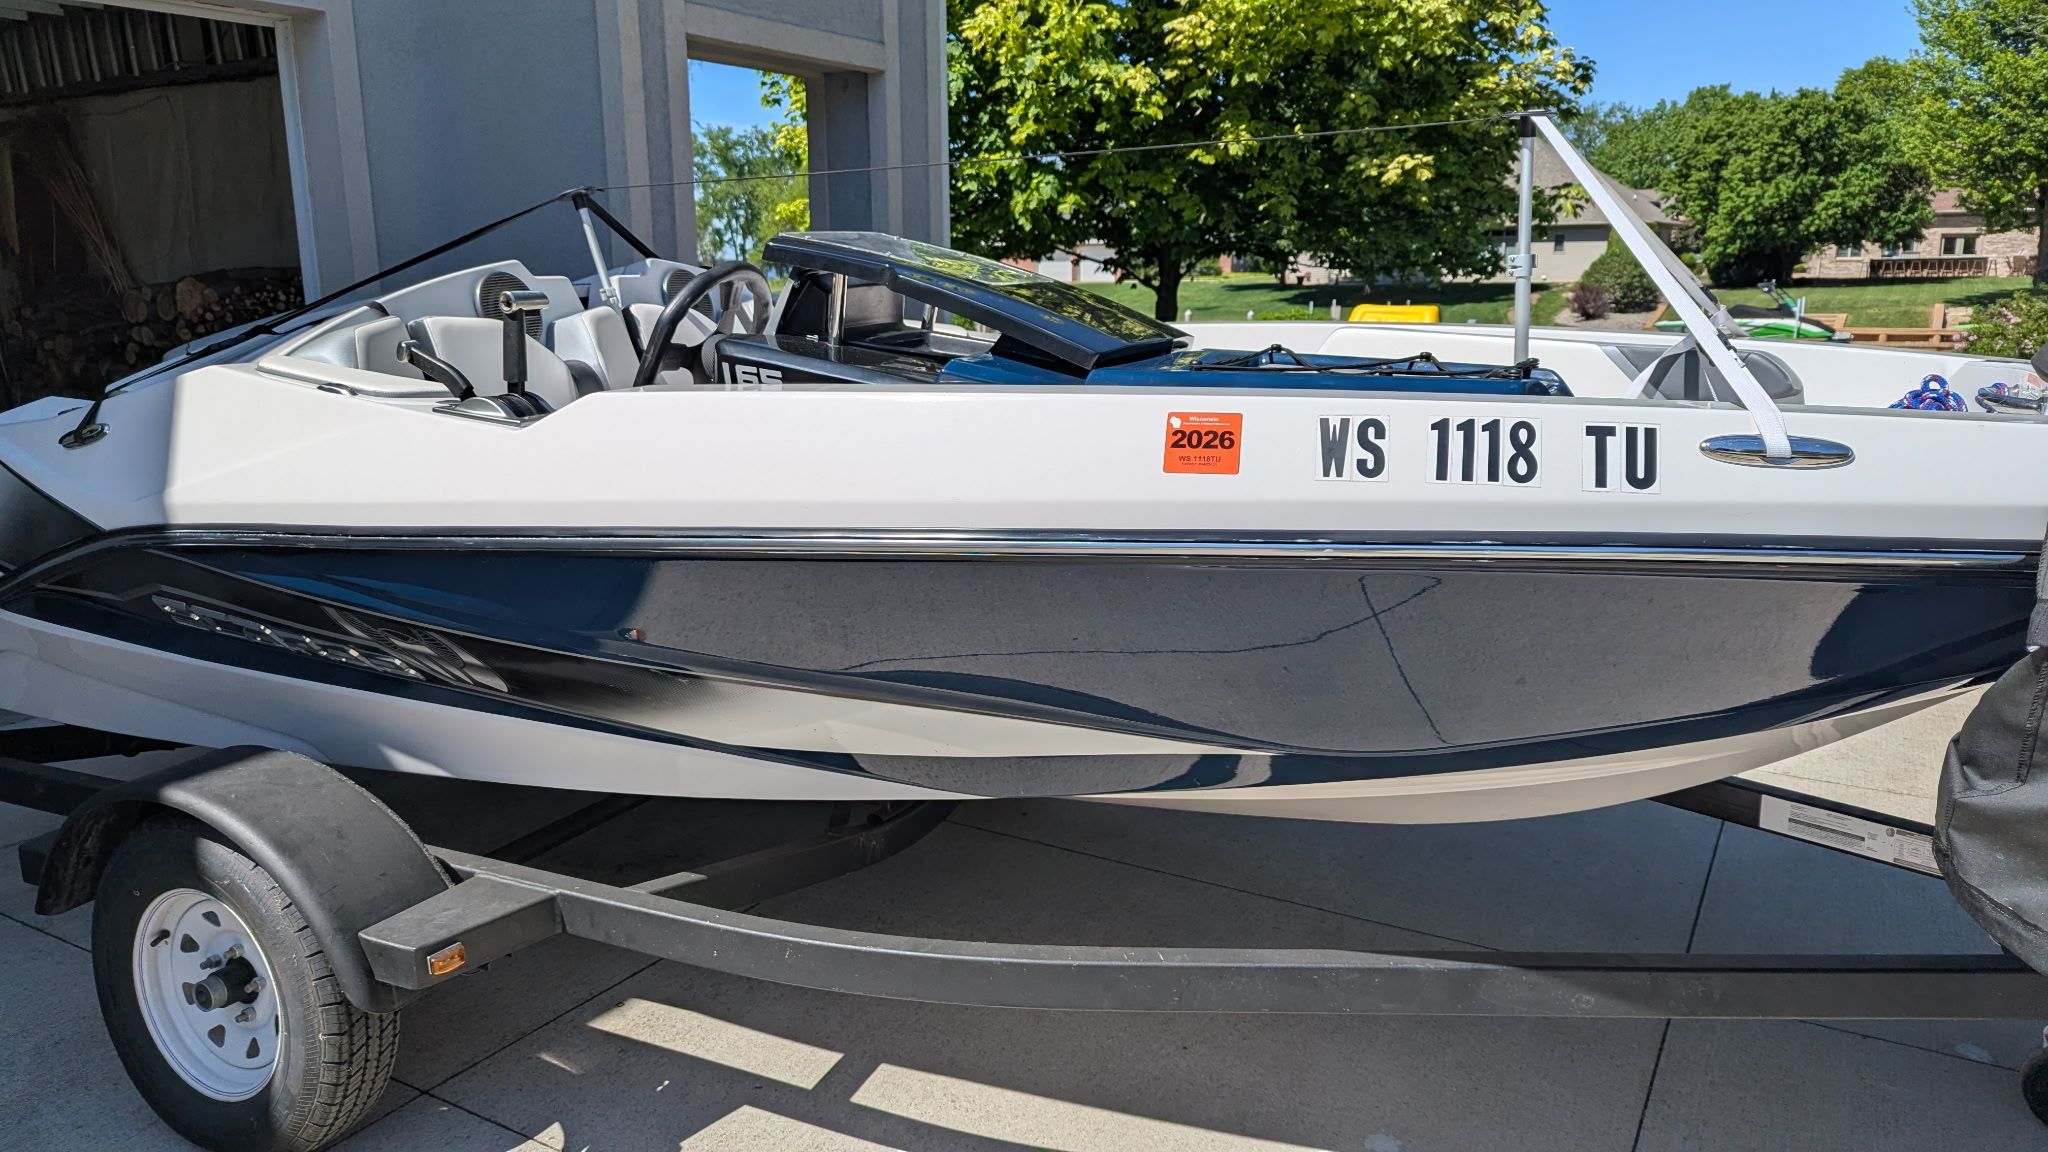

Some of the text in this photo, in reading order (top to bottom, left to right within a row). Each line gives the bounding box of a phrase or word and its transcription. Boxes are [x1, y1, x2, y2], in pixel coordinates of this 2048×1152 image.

[1169, 429, 1235, 450] 2026
[1319, 417, 1658, 490] WS 1118 TU
